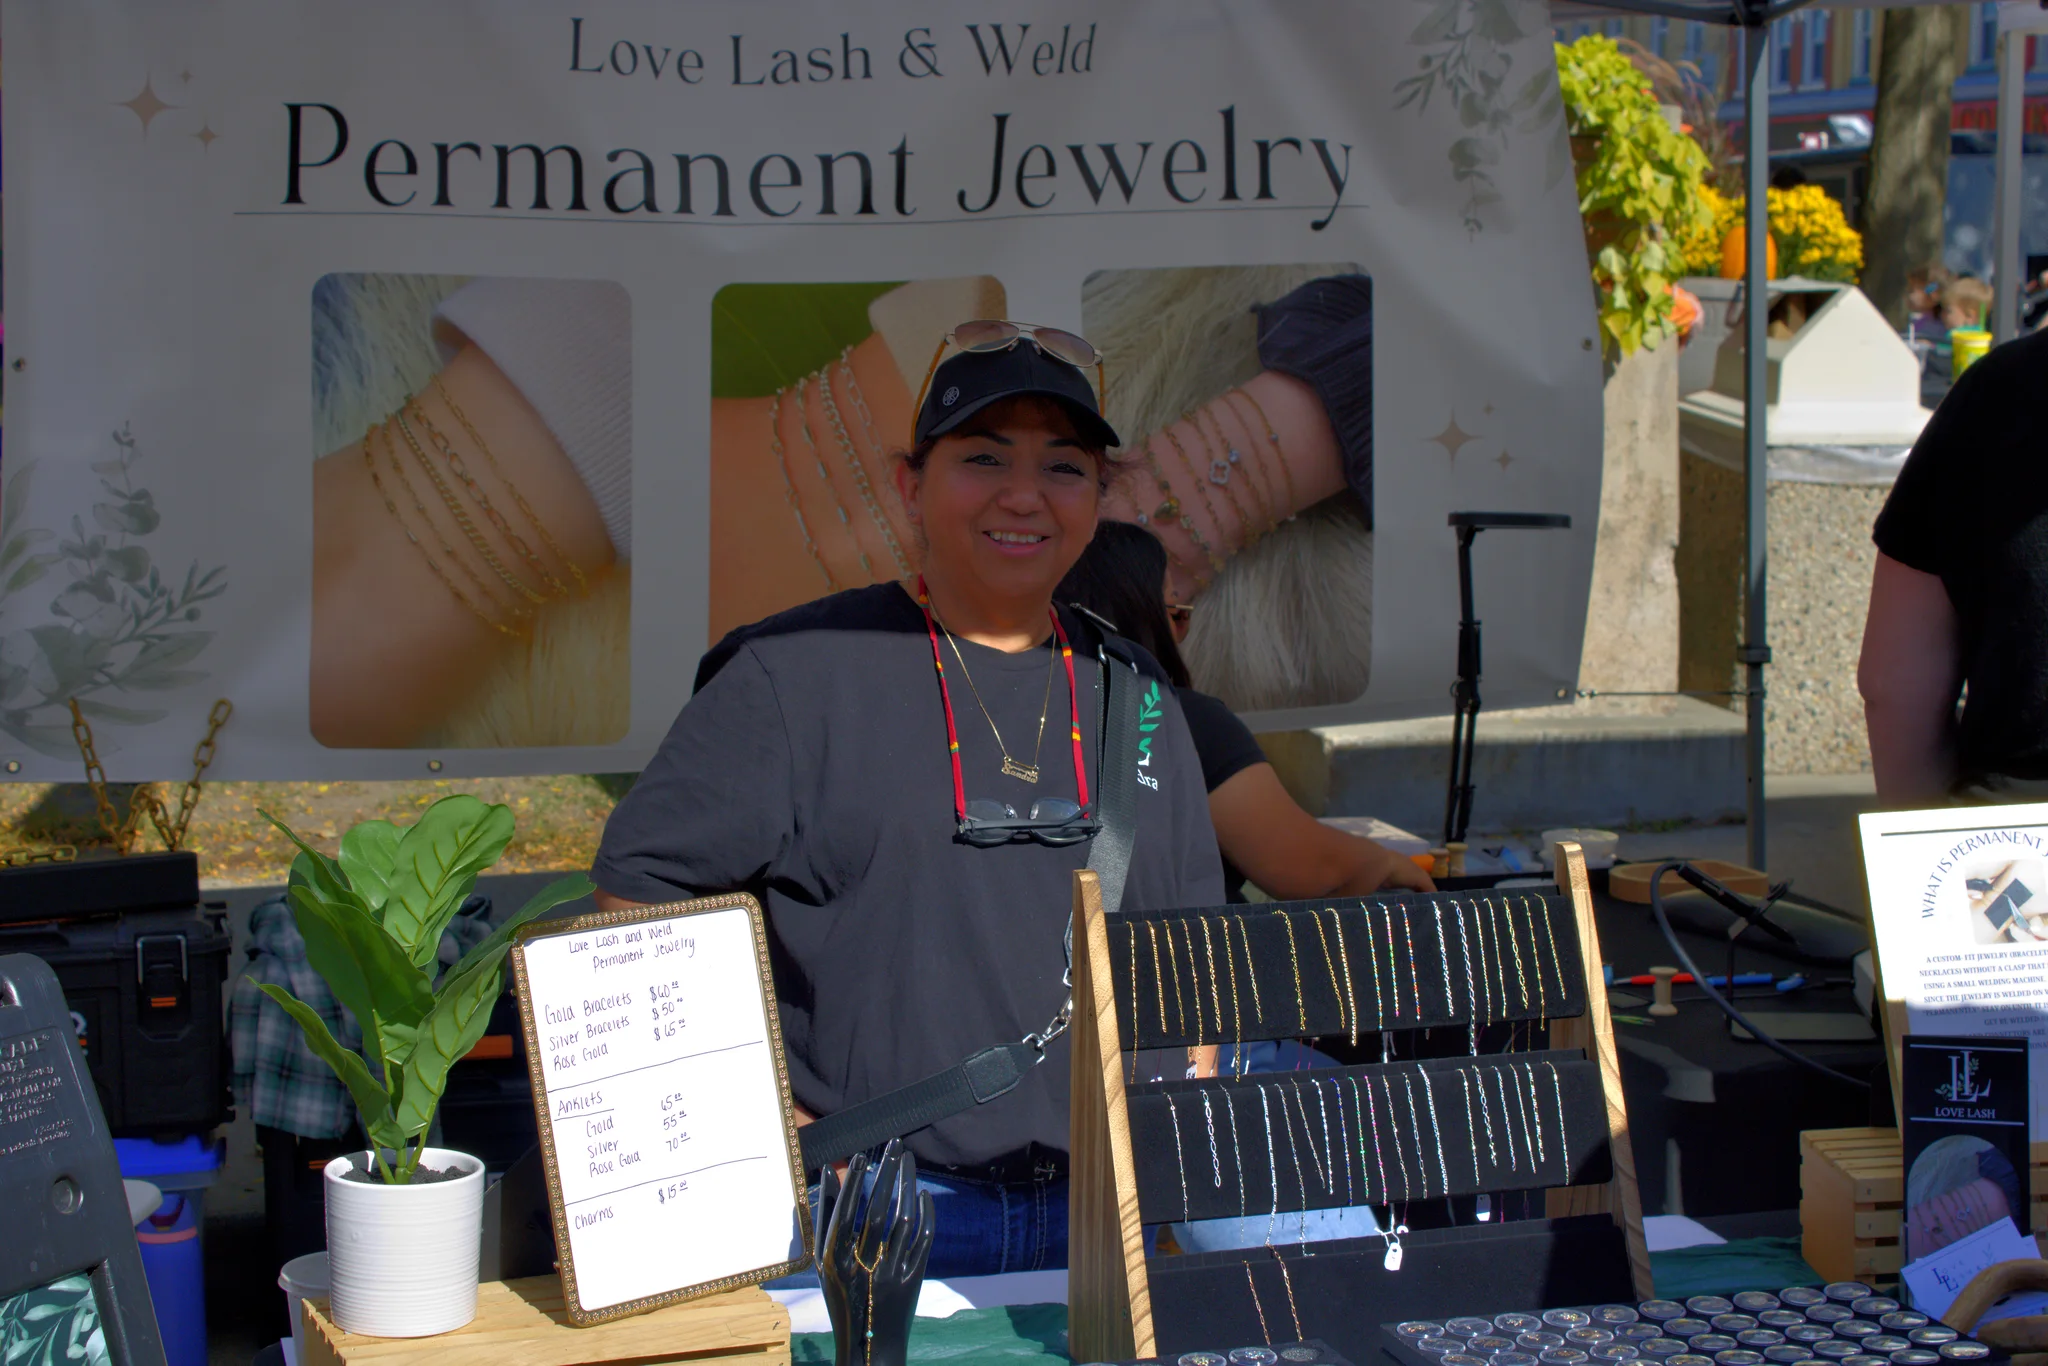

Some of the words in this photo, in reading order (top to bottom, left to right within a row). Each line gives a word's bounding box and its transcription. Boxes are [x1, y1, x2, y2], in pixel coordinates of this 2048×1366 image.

[569, 17, 705, 85] Love
[730, 33, 872, 87] Lash
[899, 27, 944, 79] &
[965, 21, 1097, 78] Weld
[280, 102, 917, 217] Permanent
[957, 104, 1353, 232] Jewelry
[1922, 872, 1942, 918] WHAT
[1937, 857, 1952, 873] IS
[1949, 830, 2044, 861] PERMANENT
[568, 940, 590, 954] Love
[596, 934, 619, 948] Lash
[625, 931, 643, 944] and
[647, 923, 673, 940] Weld
[592, 949, 645, 973] Permanent
[653, 937, 695, 958] Jewelry
[1964, 953, 1975, 961] FIT
[1976, 952, 2008, 962] JEWELRY
[1919, 968, 1962, 977] NECKLACES)
[1963, 965, 1996, 974] WITHOUT
[2027, 962, 2046, 970] THAT
[1923, 995, 1944, 1003] SINCE
[1946, 994, 1960, 1002] THE
[1961, 992, 1992, 1002] JEWELRY
[1993, 992, 2001, 1000] IS
[2002, 990, 2031, 998] WELDED
[1924, 982, 1945, 990] USING
[1953, 980, 1977, 988] SMALL
[1977, 978, 2011, 986] WELDING
[545, 1004, 575, 1025] Gold
[583, 993, 632, 1018] Bracelets
[549, 1031, 579, 1052] Silver
[586, 1016, 630, 1039] Bracelets
[553, 1054, 576, 1072] Rose
[582, 1043, 608, 1062] Gold
[557, 1091, 603, 1116] Anklets
[1935, 1107, 1965, 1117] LOVE
[1967, 1108, 1996, 1119] LASH
[586, 1116, 614, 1138] Gold
[587, 1138, 619, 1159] Silver
[589, 1159, 614, 1178] Rose
[618, 1151, 642, 1169] Gold
[574, 1206, 614, 1230] Charms
